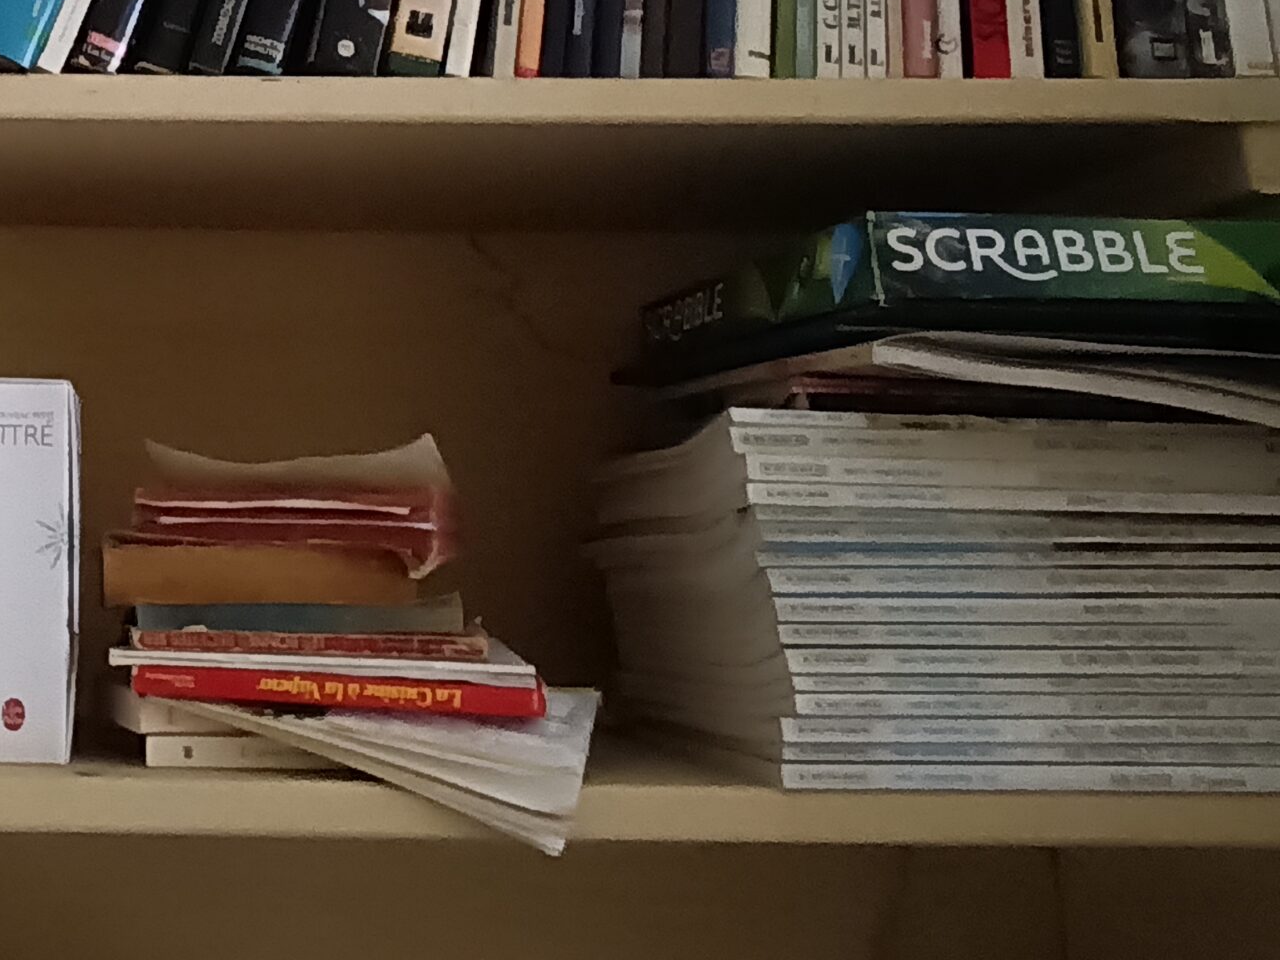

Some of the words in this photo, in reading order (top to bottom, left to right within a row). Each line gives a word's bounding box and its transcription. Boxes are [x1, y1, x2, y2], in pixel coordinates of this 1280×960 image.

[886, 226, 1205, 281] SCRABBLE
[256, 673, 321, 700] Vapeur
[323, 681, 344, 700] la
[347, 682, 360, 699] à
[362, 683, 432, 705] Cuisine
[434, 687, 462, 707] La
